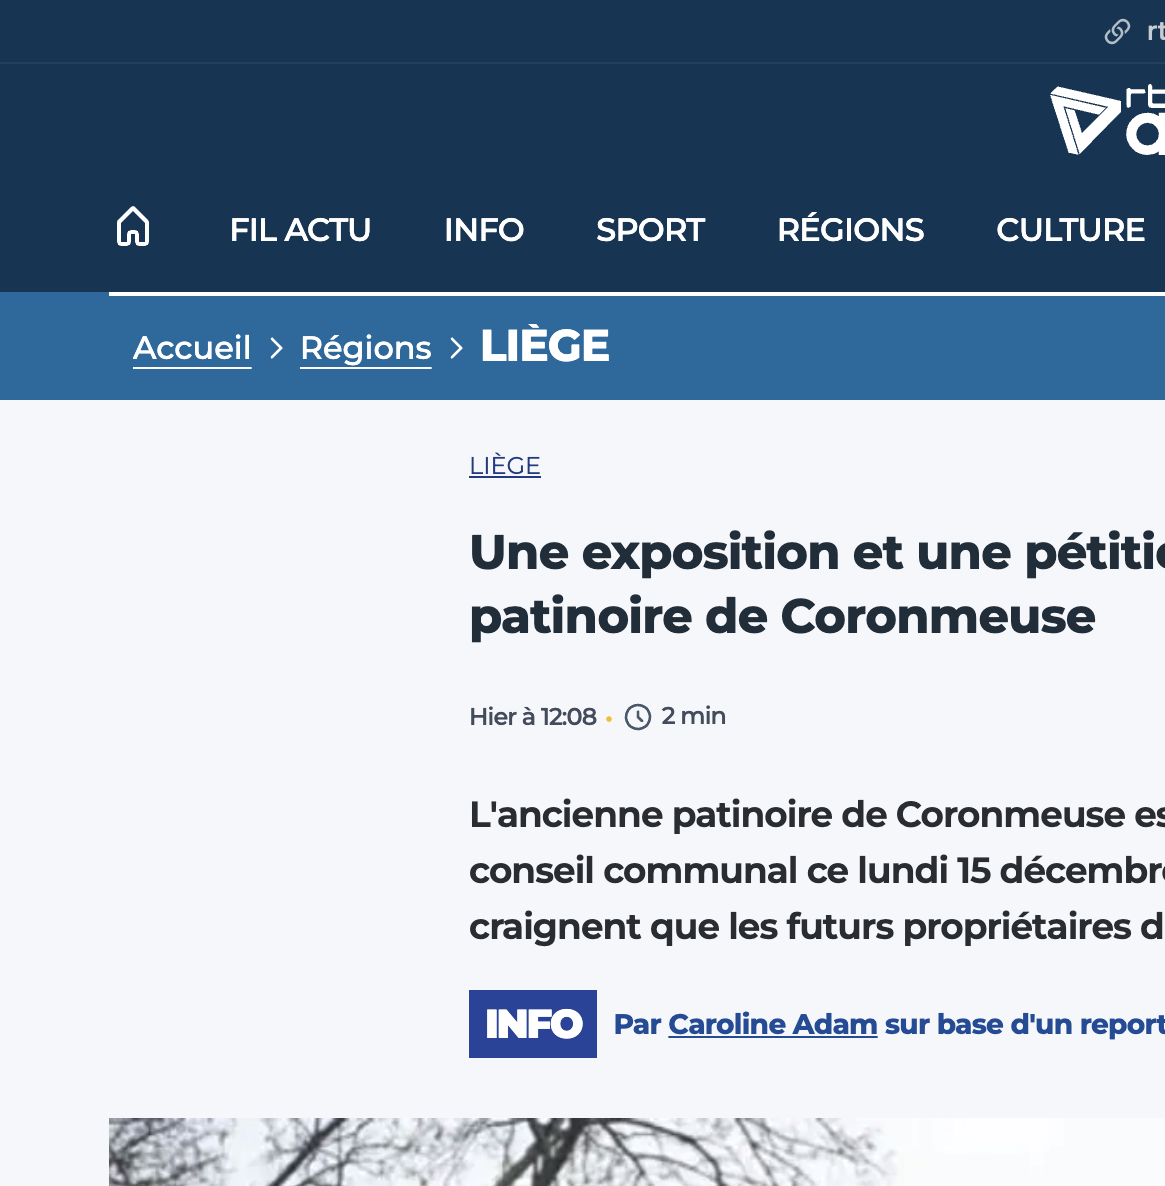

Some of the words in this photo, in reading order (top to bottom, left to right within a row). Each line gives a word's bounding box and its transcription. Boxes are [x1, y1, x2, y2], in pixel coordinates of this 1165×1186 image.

[232, 218, 277, 241] FIL
[284, 218, 370, 242] ACTU
[446, 218, 524, 242] INFO
[597, 218, 706, 242] SPORT
[779, 212, 924, 242] RÉGIONS
[997, 218, 1145, 242] CULTURE
[133, 334, 249, 359] Accueil
[303, 334, 431, 366] Régions
[483, 324, 609, 362] LIÈGE
[471, 452, 540, 474] LIÈGE
[472, 535, 568, 570] Une
[583, 530, 838, 578] exposition
[854, 537, 904, 570] et
[919, 542, 1011, 570] une
[472, 594, 692, 642] patinoire
[706, 597, 767, 634] de
[782, 598, 1095, 634] Coronmeuse
[471, 706, 517, 725] Hier
[523, 707, 534, 725] à
[541, 708, 597, 725] 12:08
[662, 707, 675, 724] 2
[682, 705, 725, 724] min
[472, 798, 663, 827] L'ancienne
[674, 798, 832, 834] patinoire
[842, 800, 887, 827] de
[897, 801, 1125, 827] Coronmeuse
[470, 854, 592, 883] conseil
[604, 856, 796, 883] communal
[808, 863, 848, 883] ce
[860, 854, 947, 883] lundi
[957, 857, 991, 883] 15
[470, 910, 641, 946] craignent
[651, 919, 719, 946] que
[731, 912, 778, 939] les
[787, 912, 894, 939] futurs
[905, 910, 1131, 946] propriétaires
[487, 1009, 583, 1039] INFO
[615, 1014, 661, 1034] Par
[669, 1011, 786, 1034] Caroline
[792, 1013, 877, 1034] Adam
[885, 1018, 930, 1034] sur
[938, 1013, 1003, 1034] base
[1011, 1013, 1072, 1034] d'un
